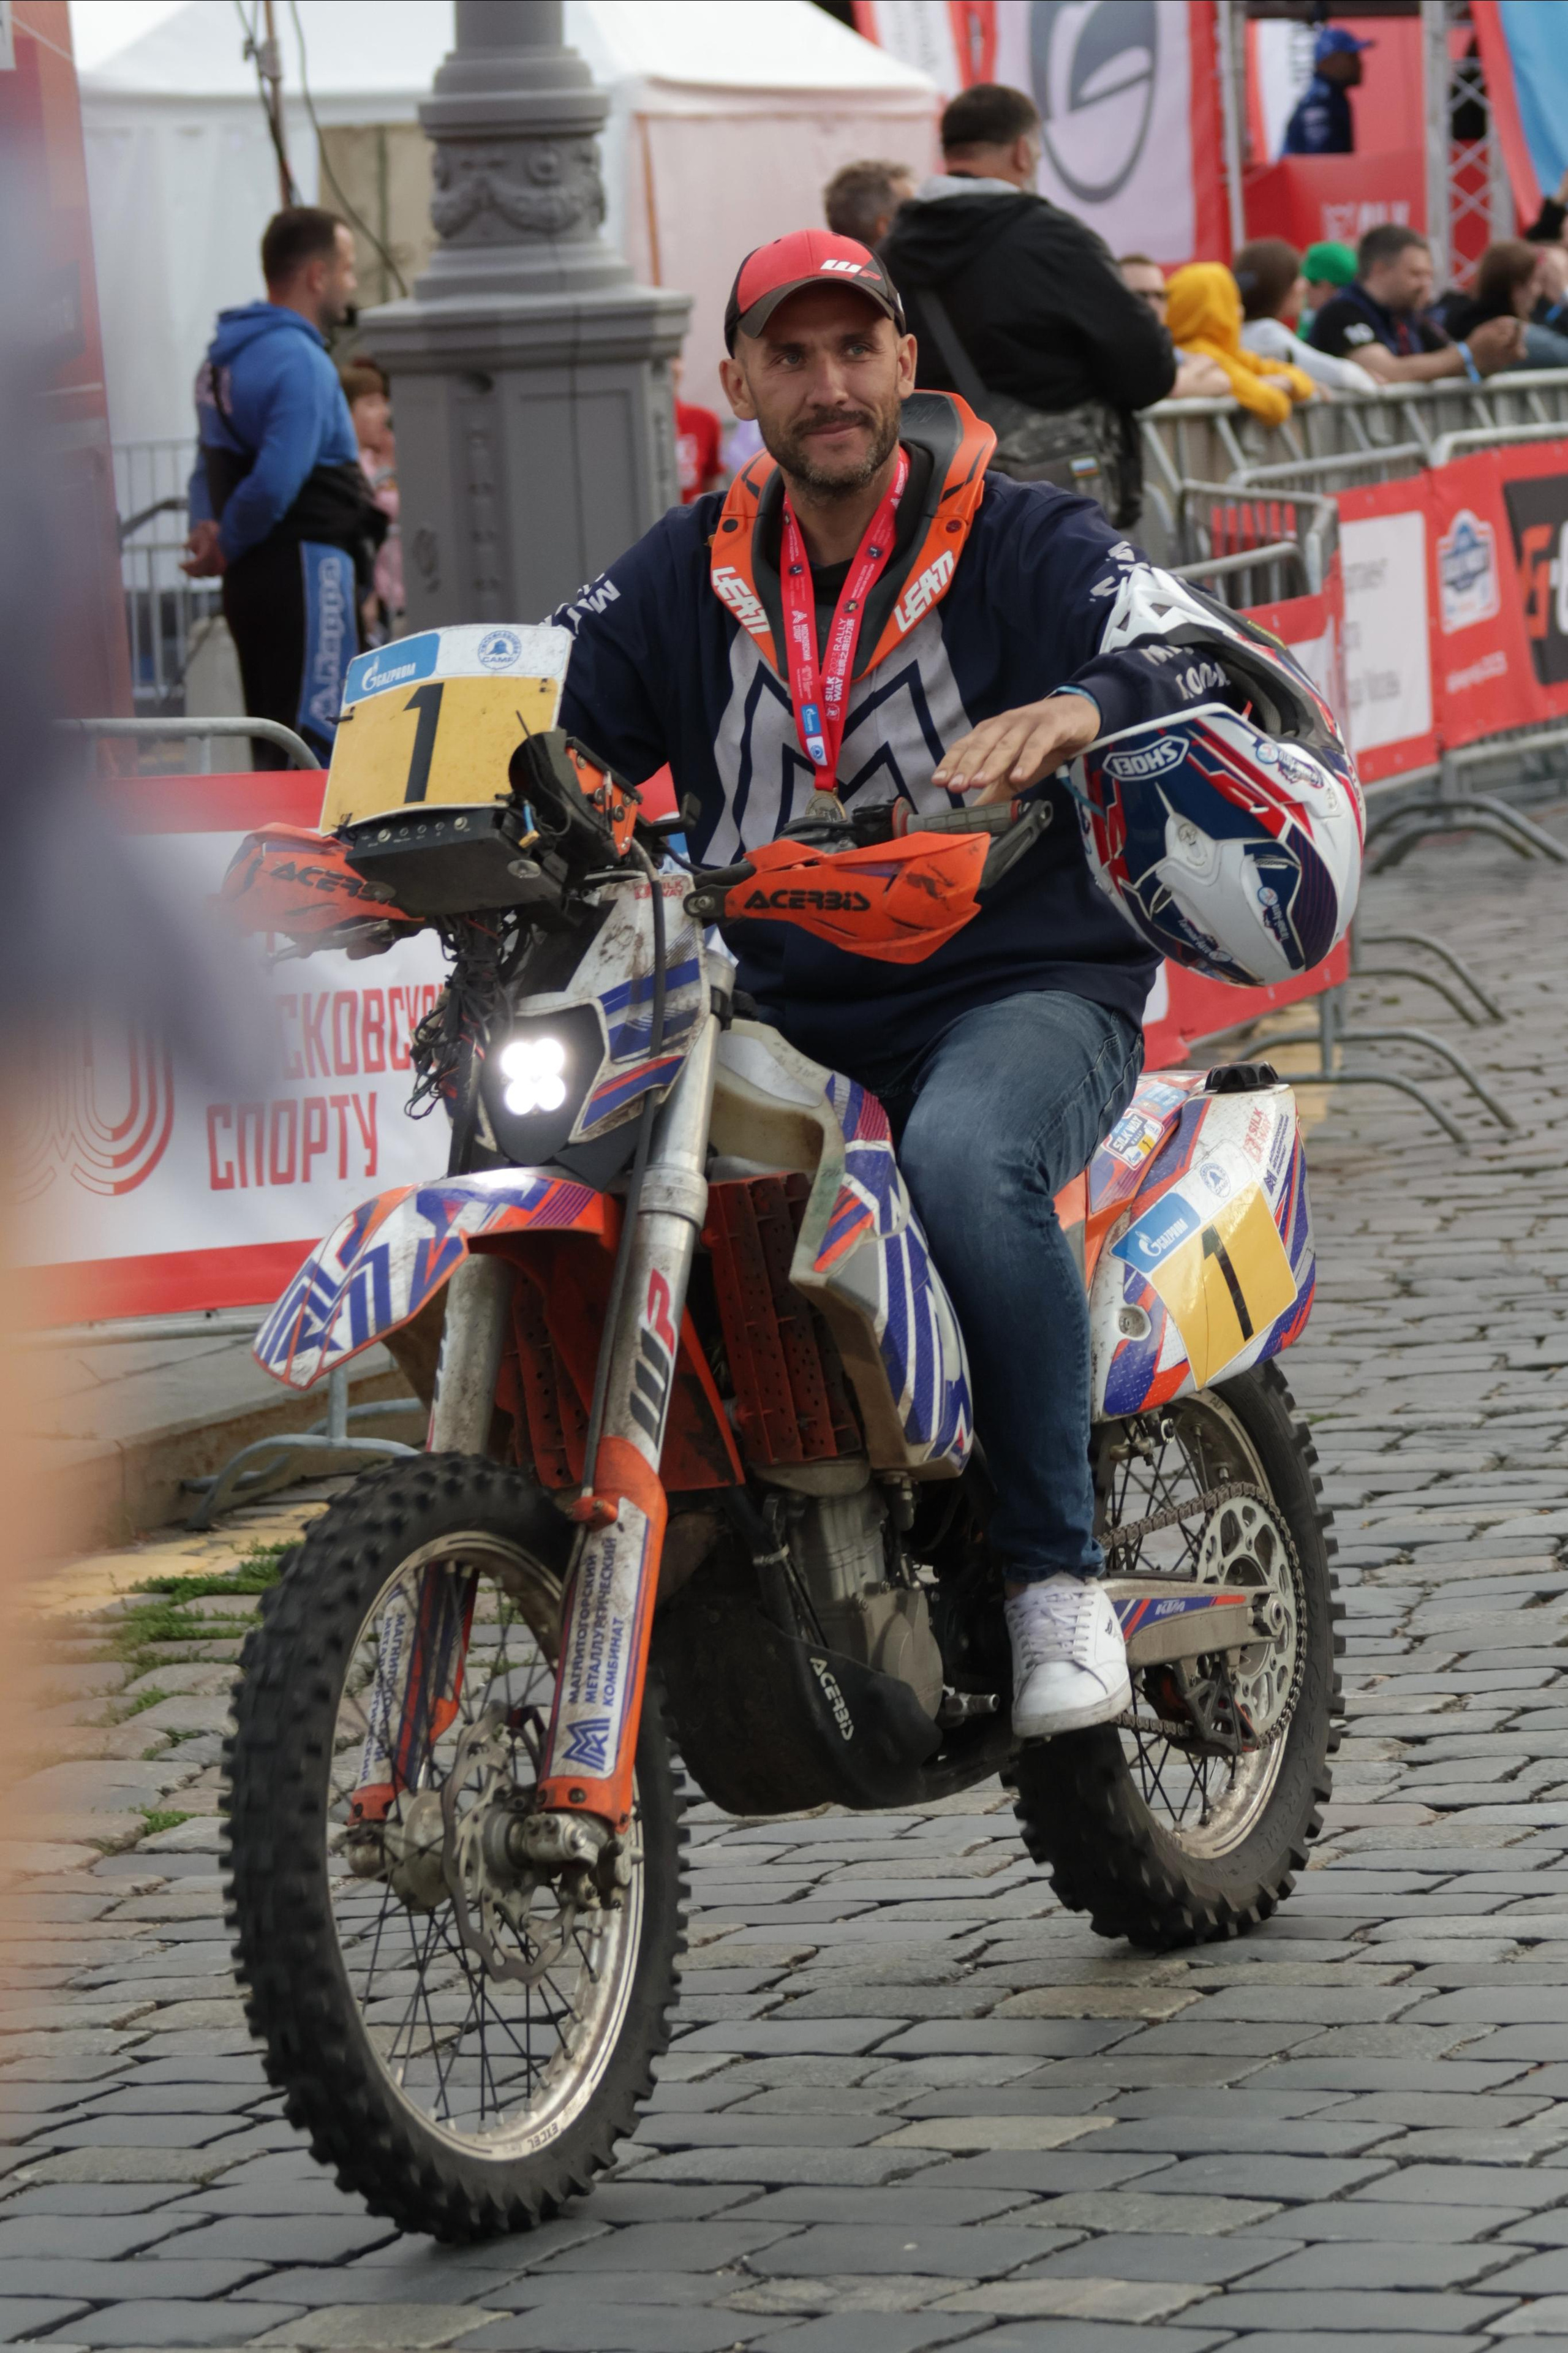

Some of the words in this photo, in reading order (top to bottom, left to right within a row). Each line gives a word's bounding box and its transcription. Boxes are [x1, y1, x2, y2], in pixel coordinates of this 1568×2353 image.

[793, 625, 802, 643] СПОРТ
[801, 624, 812, 662] МОСКОВСКИЙ
[825, 676, 835, 701] SILK
[833, 618, 846, 651] RALLY
[834, 677, 843, 702] WAY
[403, 682, 445, 804] 1
[1112, 741, 1178, 776] SHOEI
[744, 888, 871, 912] ACERBIS
[206, 1092, 379, 1191] СПОРТУ
[1113, 1129, 1133, 1152] SILK
[1129, 1115, 1143, 1133] WAY
[1249, 1108, 1264, 1133] SILK
[1201, 1224, 1254, 1342] 1
[568, 1554, 597, 1704] МАГНИТОГОРСКИЙ
[584, 1536, 617, 1704] МЕТАЛЛУРГИЧЕСКИЙ
[1155, 1599, 1185, 1615] KTM
[603, 1617, 625, 1707] КОМБИНАТ
[810, 1657, 854, 1740] ACERBIS
